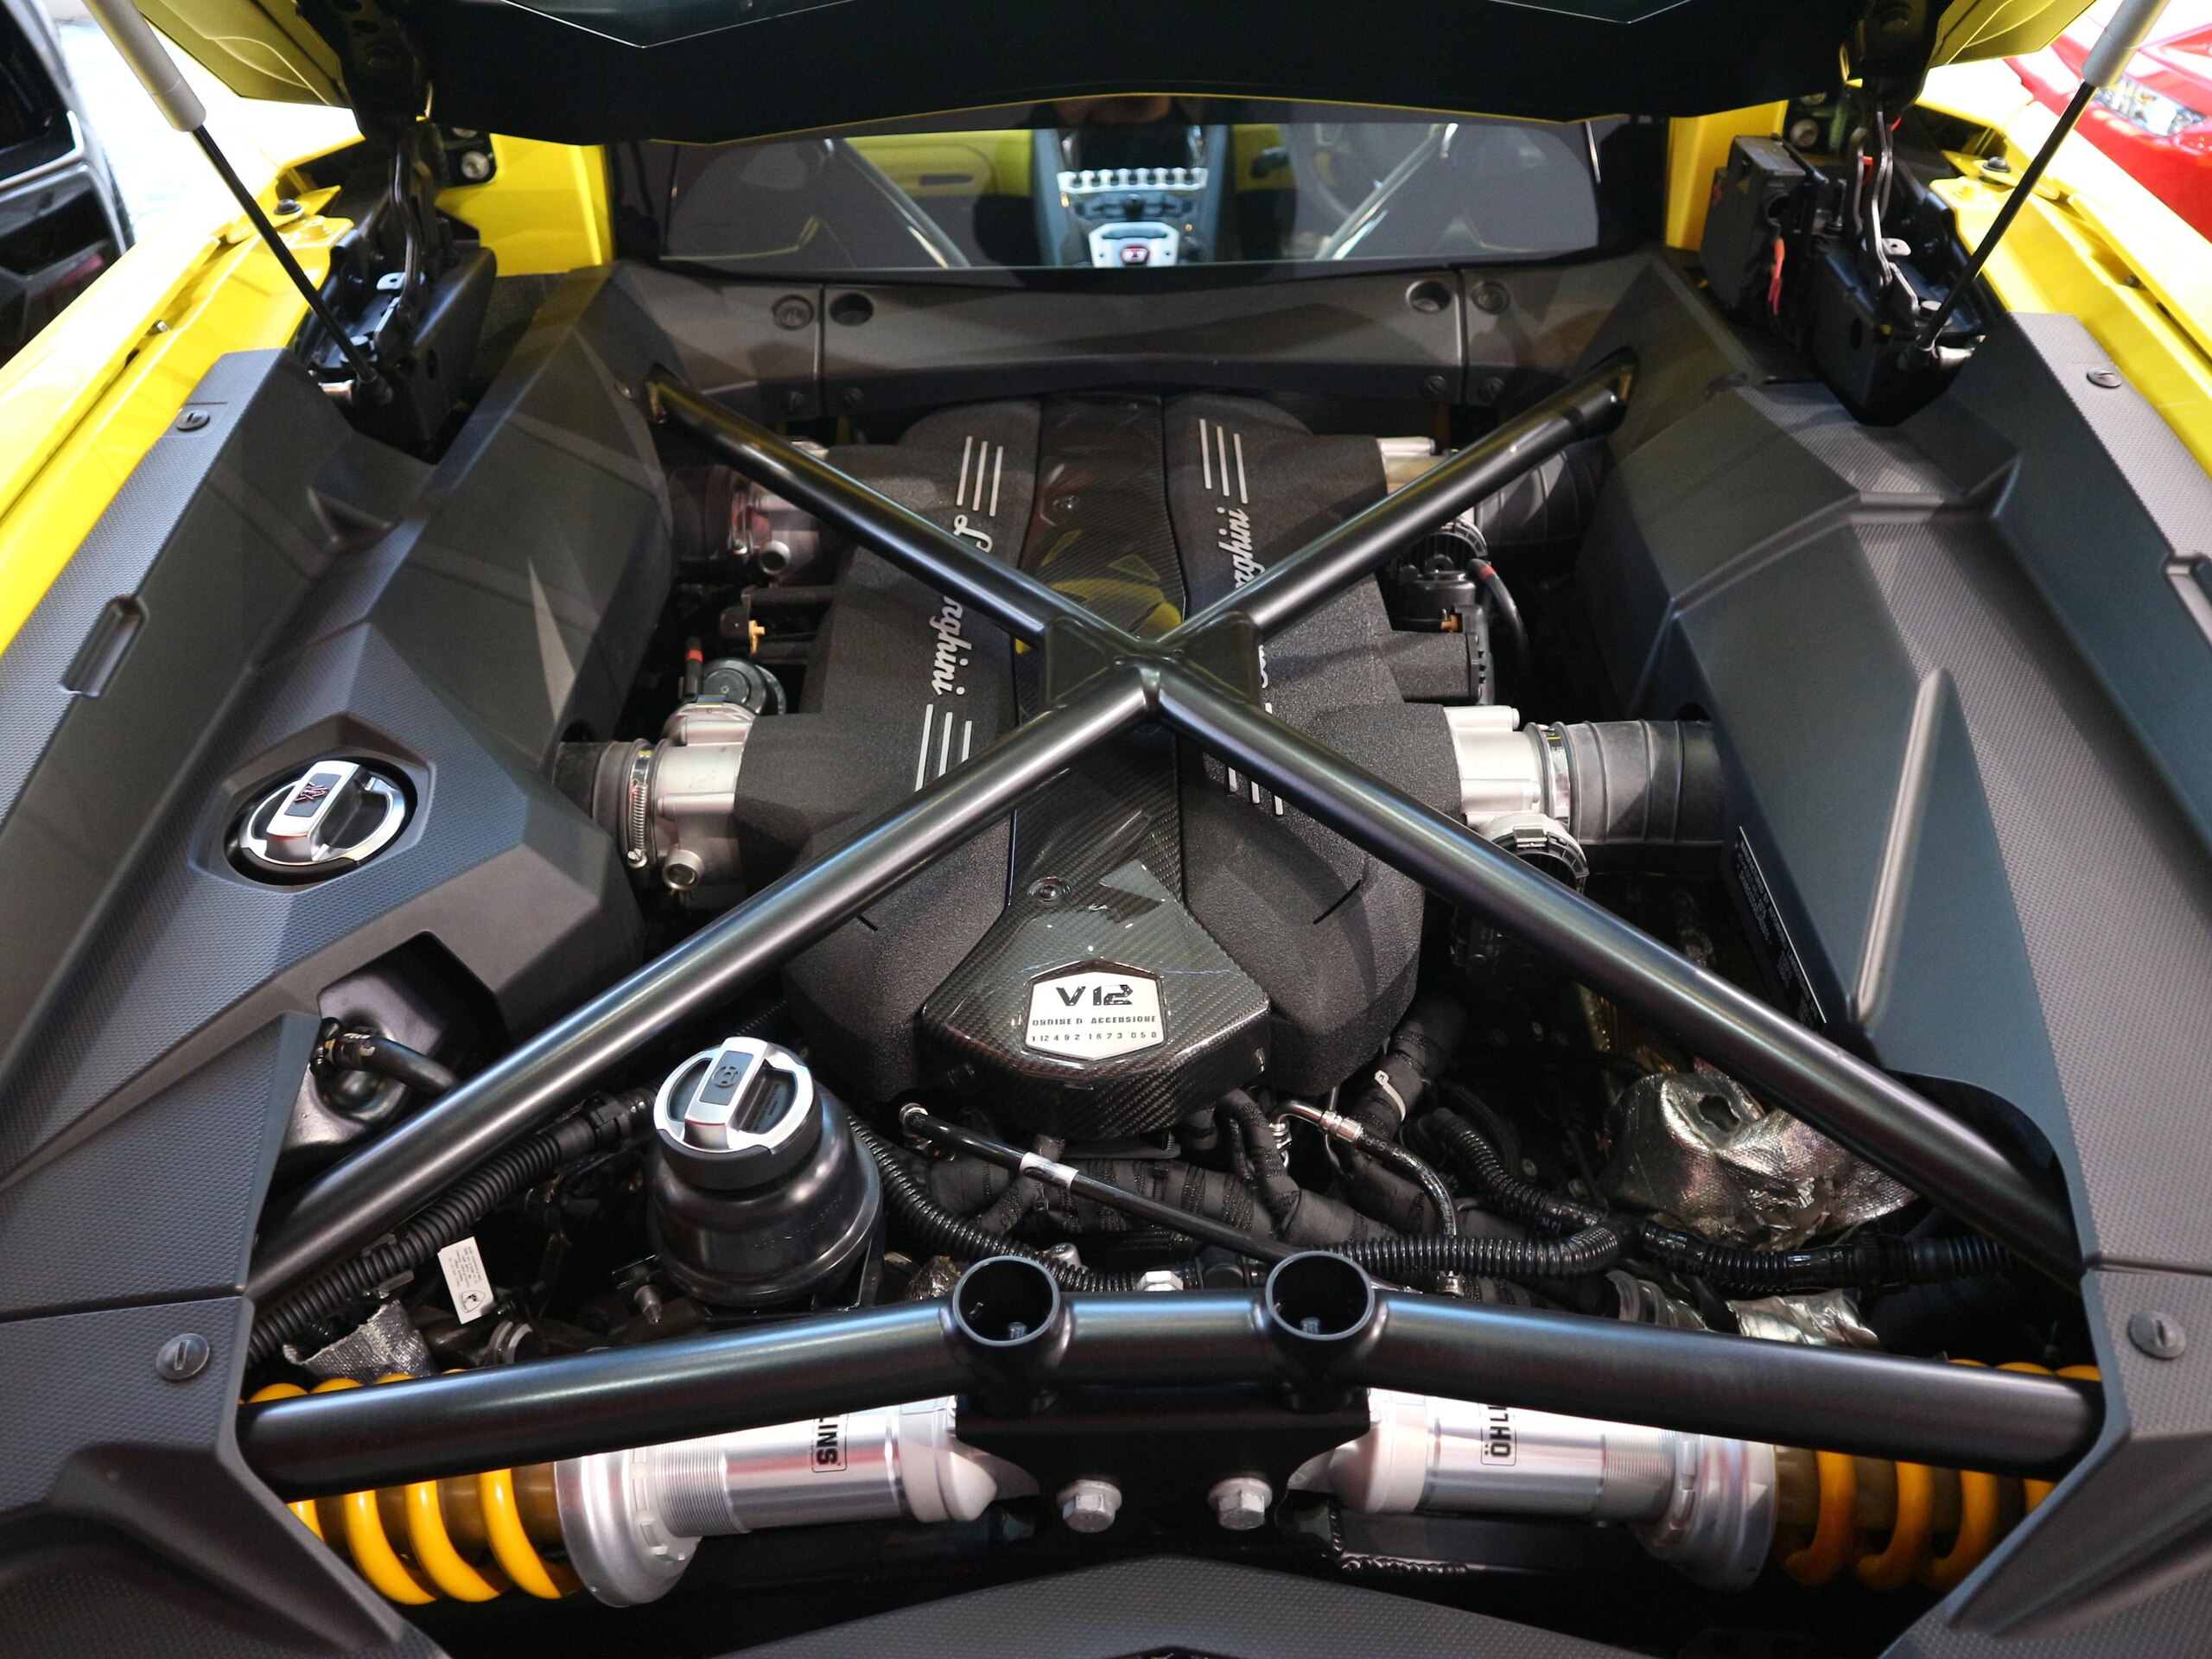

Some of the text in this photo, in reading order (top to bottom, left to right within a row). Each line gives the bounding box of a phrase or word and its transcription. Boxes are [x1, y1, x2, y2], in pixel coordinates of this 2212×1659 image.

[929, 514, 993, 696] Lrghini
[1056, 984, 1134, 1007] V12
[816, 1415, 839, 1465] INS
[1484, 1405, 1511, 1457] ÖHLI
